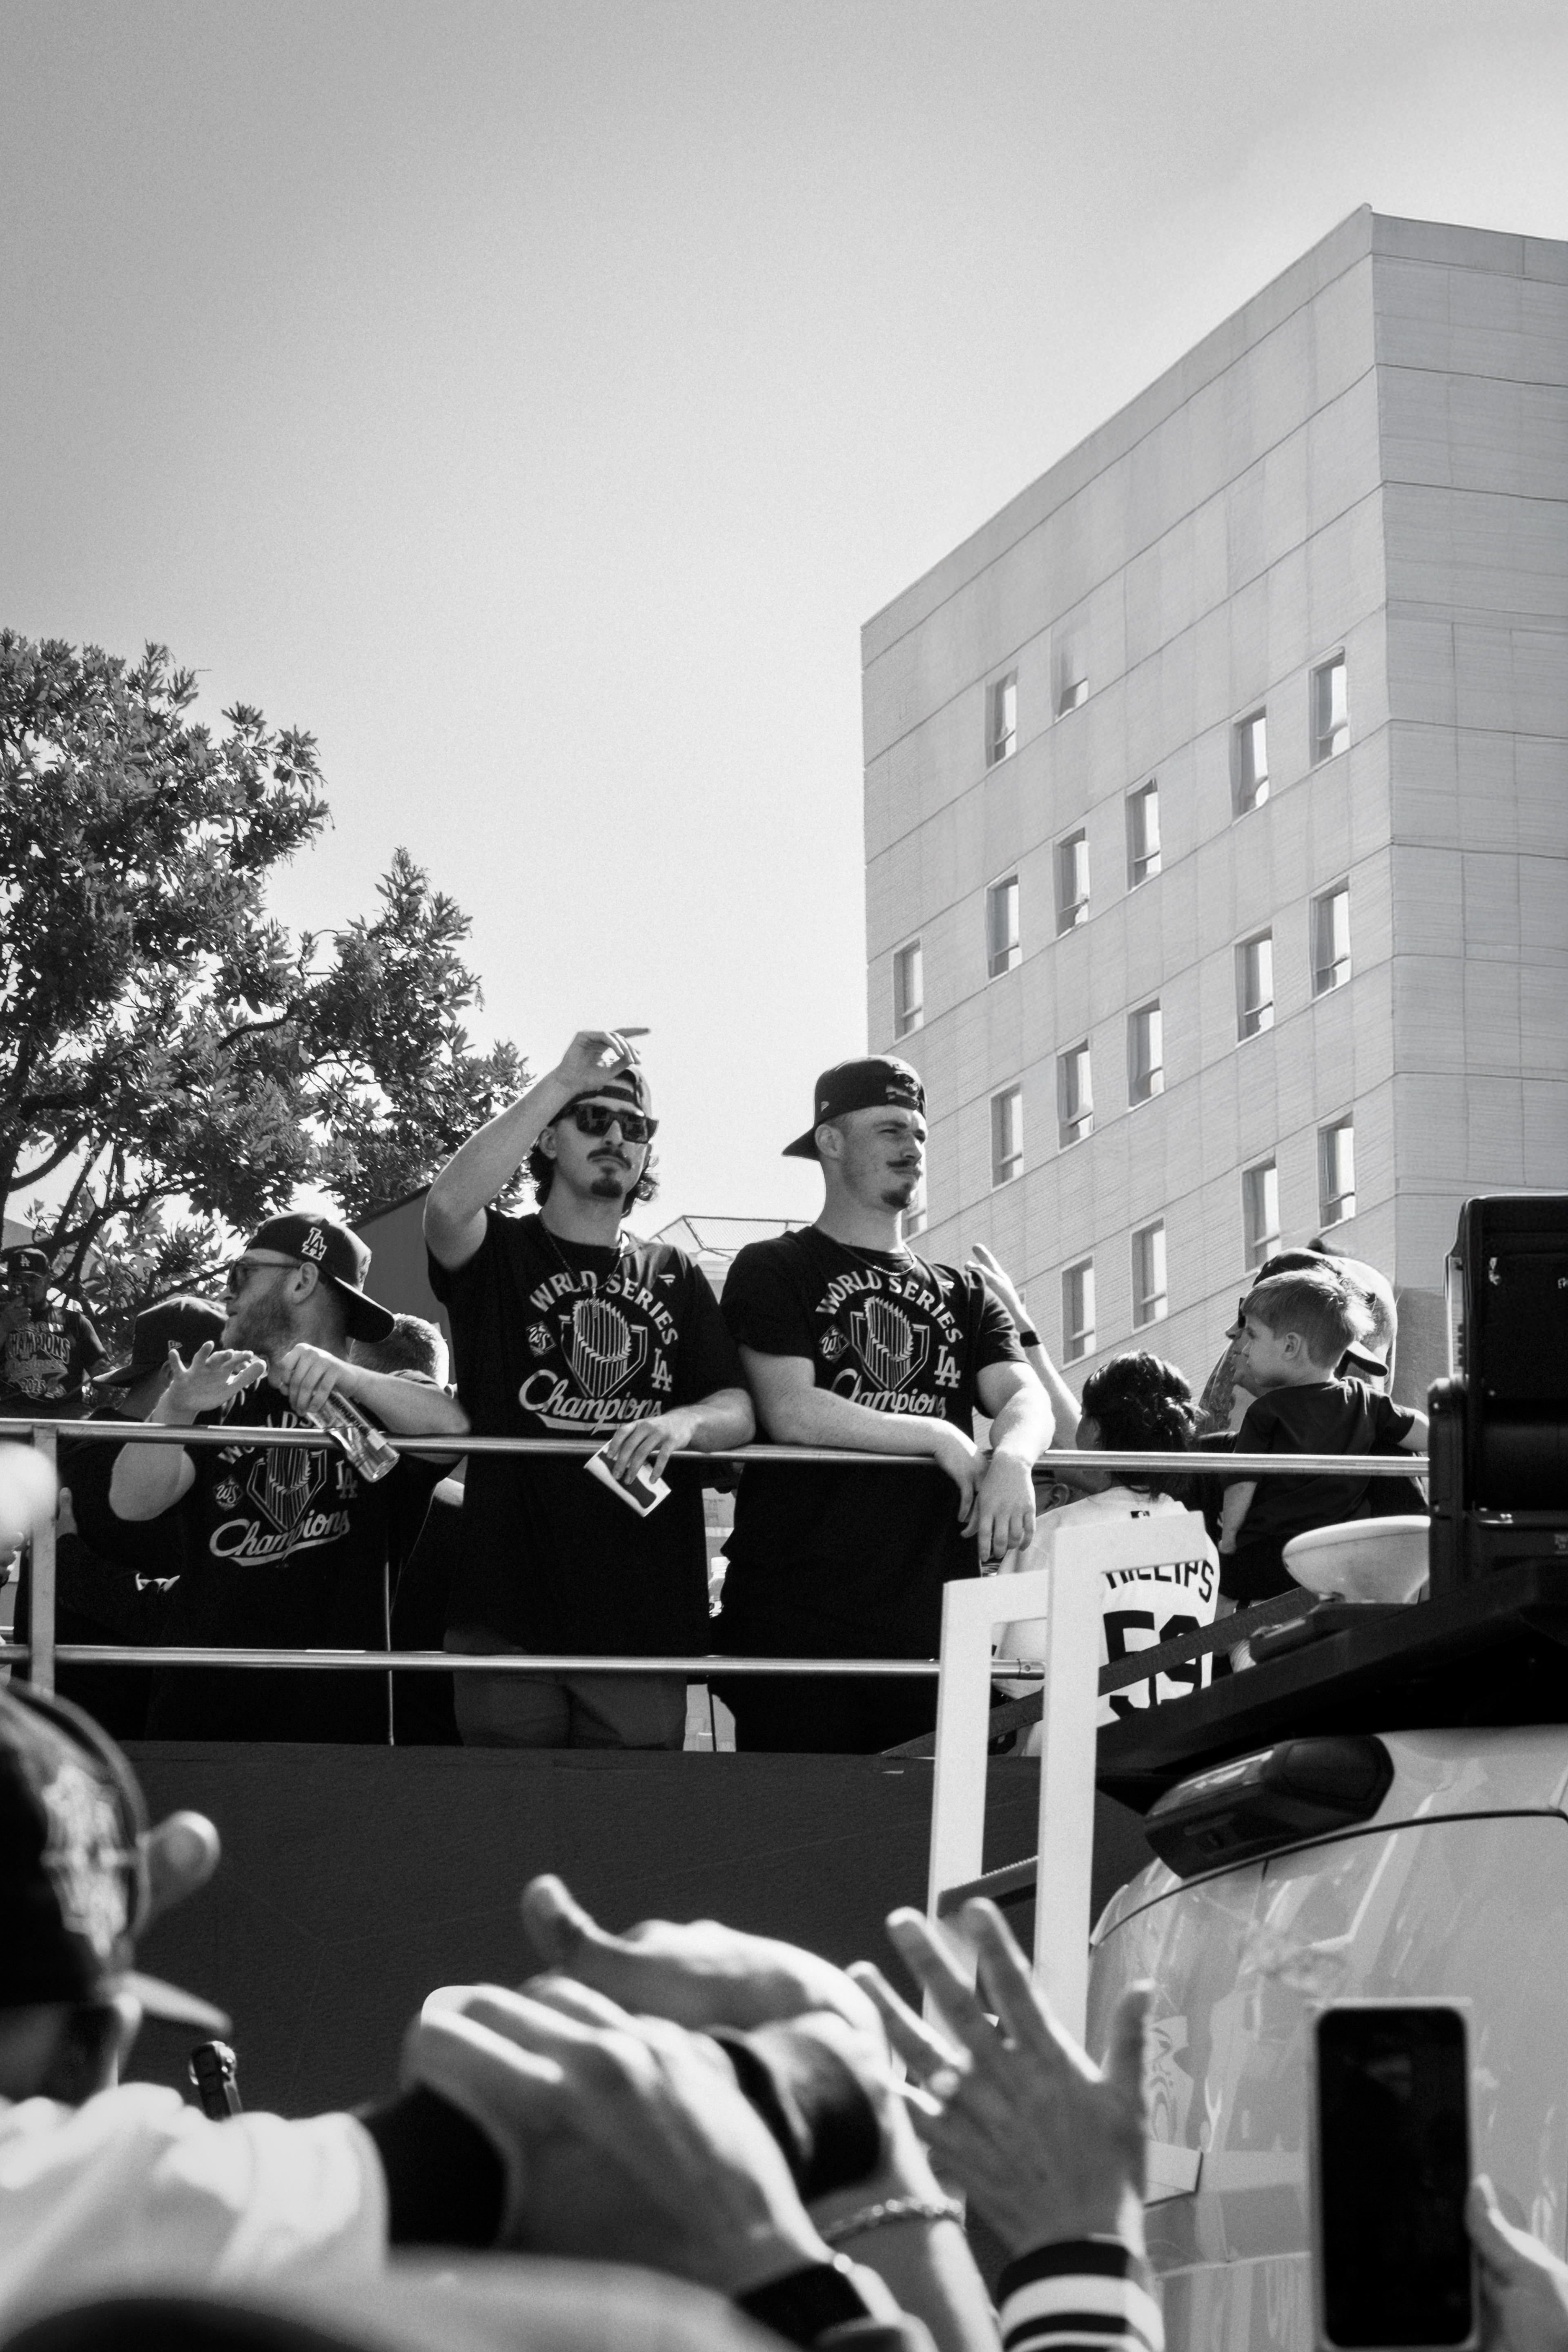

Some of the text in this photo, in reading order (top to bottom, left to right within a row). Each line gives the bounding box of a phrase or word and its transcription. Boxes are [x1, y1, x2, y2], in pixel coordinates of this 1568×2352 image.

[20, 1254, 30, 1267] LA
[301, 1227, 327, 1261] LA
[606, 1274, 679, 1345] SERIES
[815, 1270, 963, 1343] WORLD SERIES
[651, 1348, 672, 1392] LA
[934, 1345, 961, 1388] LA
[519, 1369, 662, 1435] Champions
[216, 1484, 239, 1503] WS
[336, 1459, 358, 1499] LA
[209, 1510, 350, 1561] Champions
